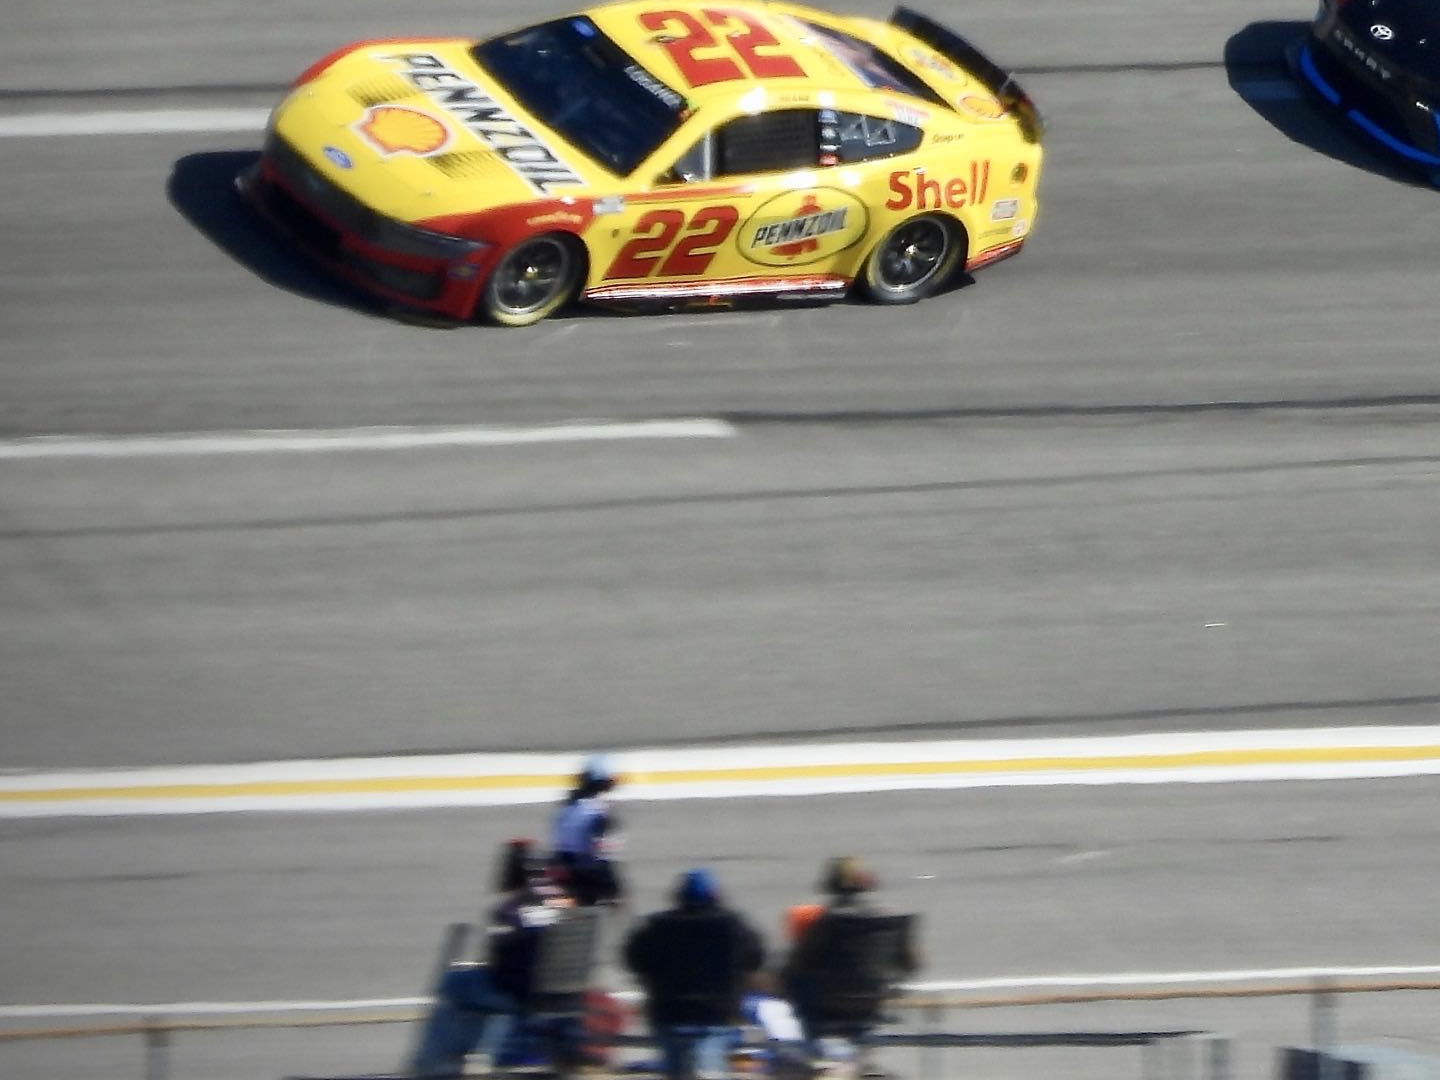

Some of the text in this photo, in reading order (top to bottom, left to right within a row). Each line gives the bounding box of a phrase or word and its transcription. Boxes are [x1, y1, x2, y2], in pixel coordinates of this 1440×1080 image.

[640, 10, 808, 88] 22
[400, 52, 588, 198] PENNZOIL
[886, 159, 990, 211] Shell
[602, 205, 739, 280] 22
